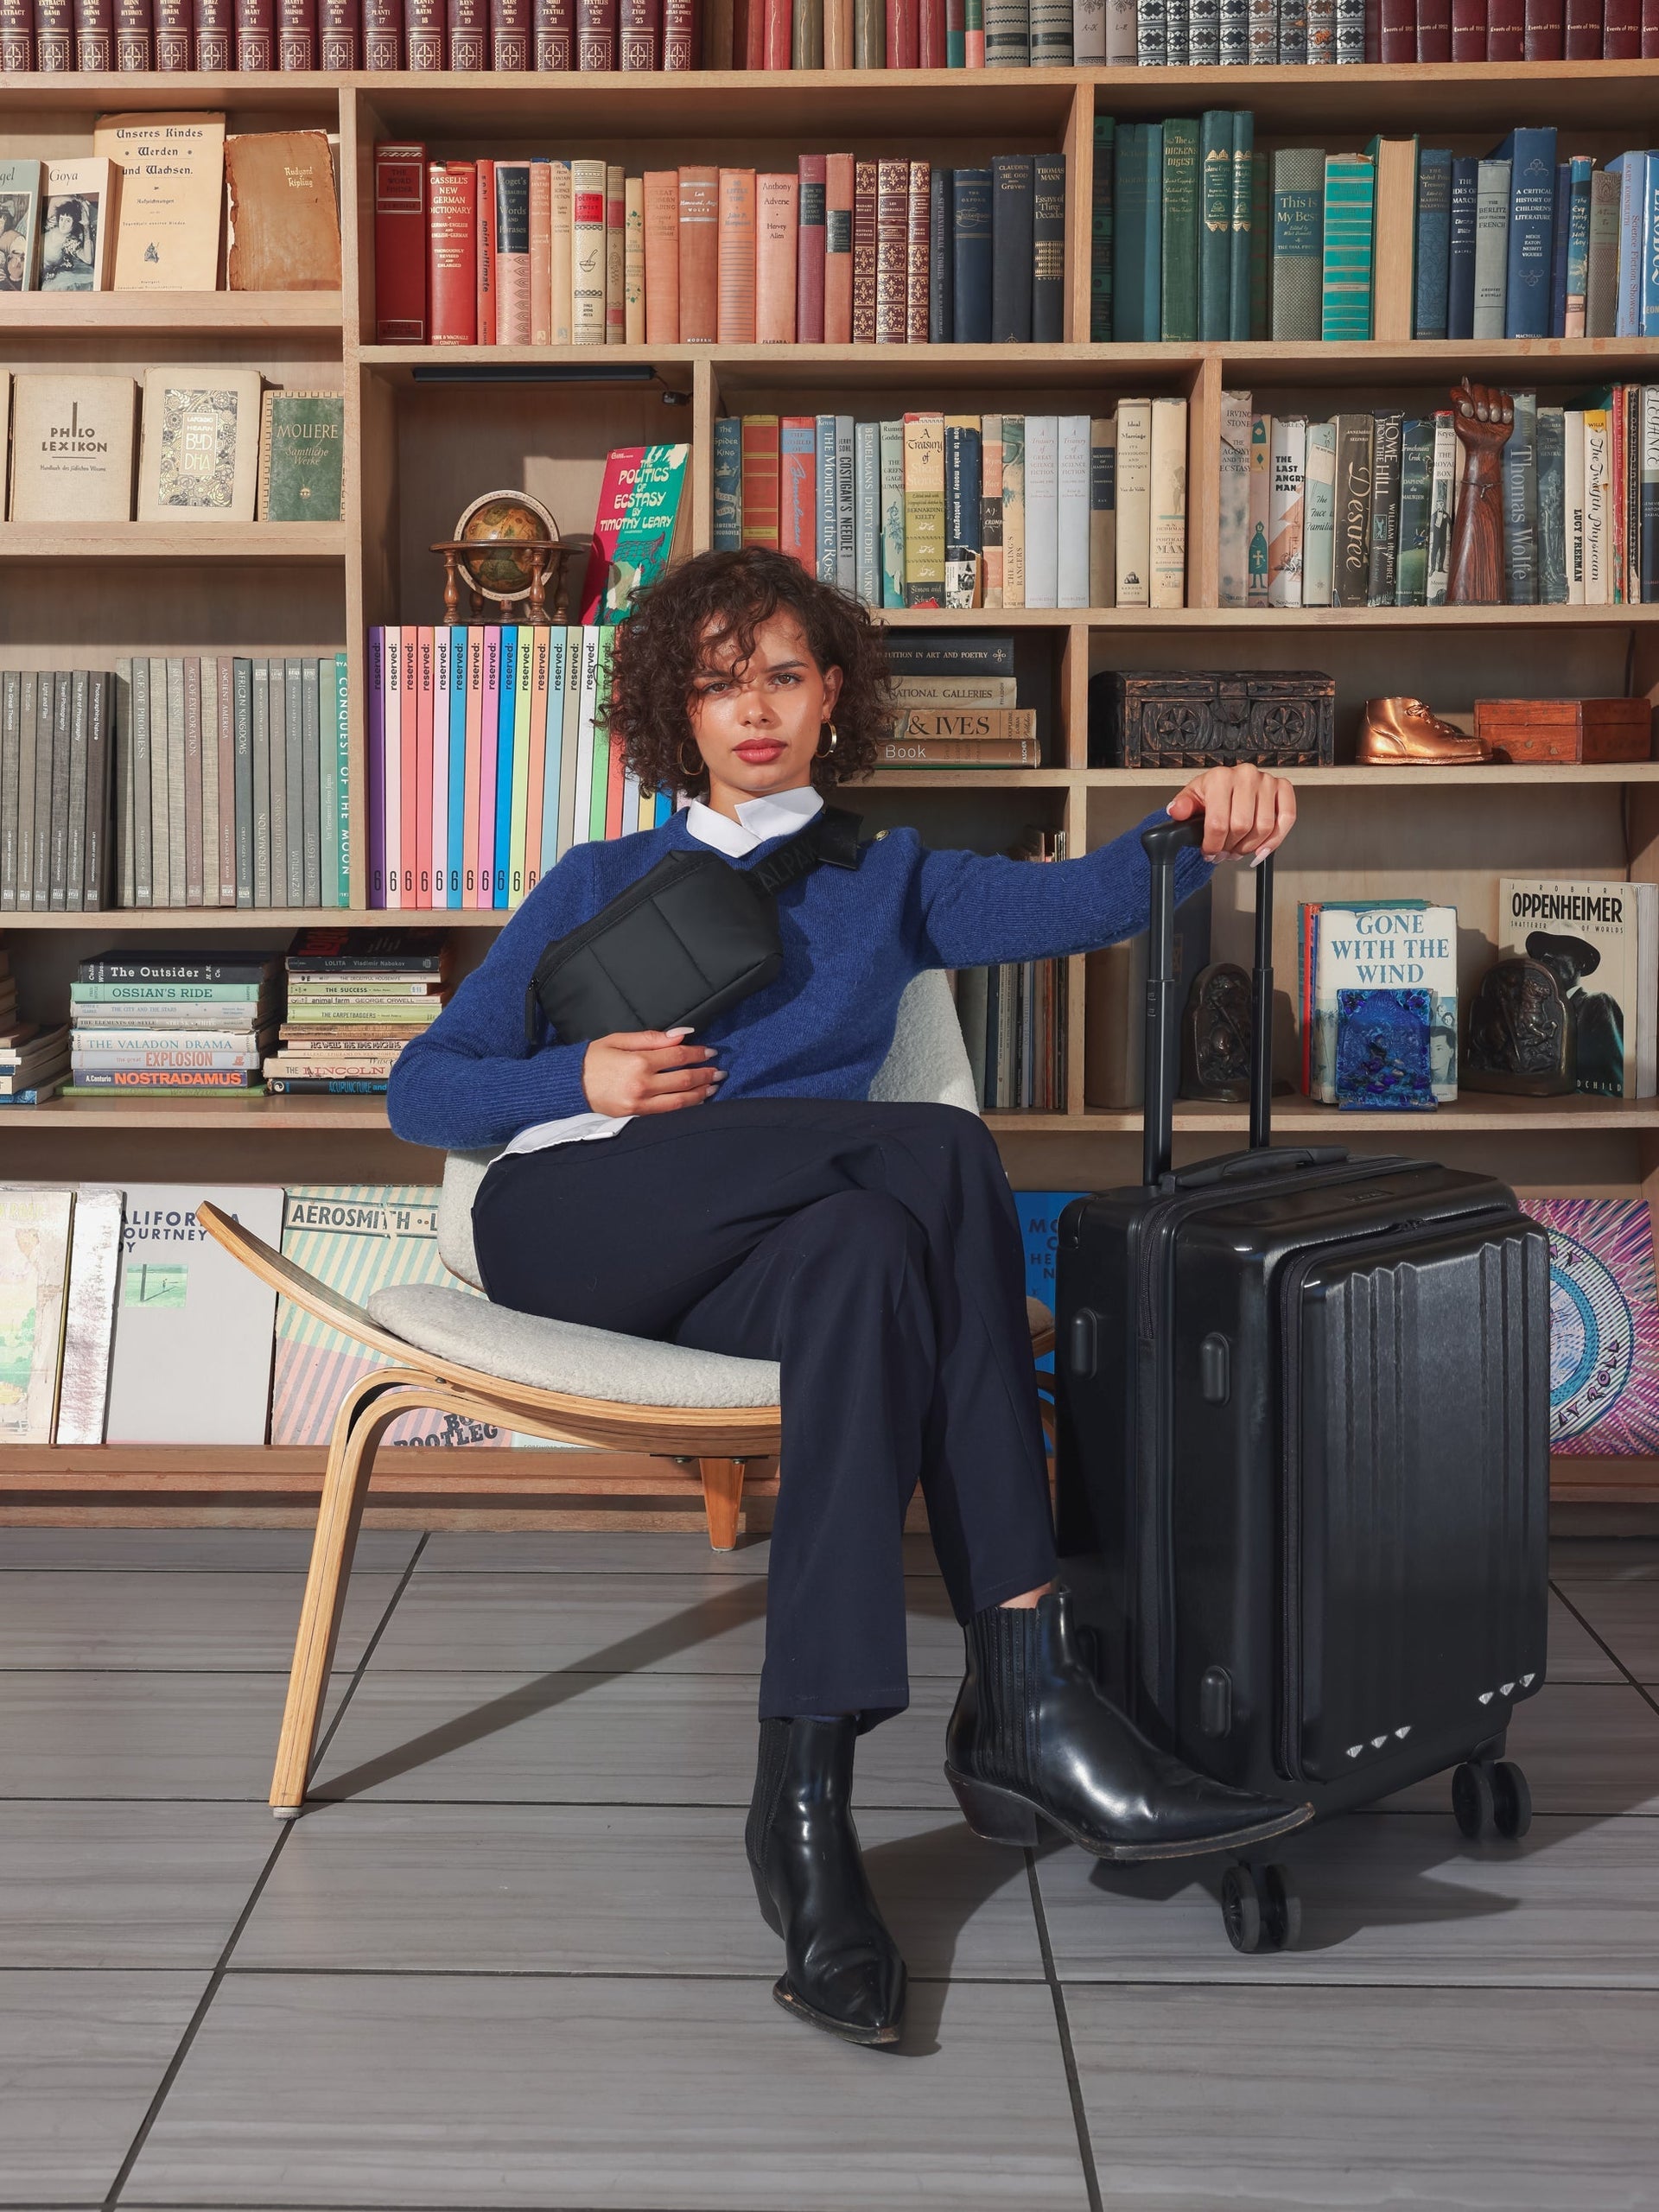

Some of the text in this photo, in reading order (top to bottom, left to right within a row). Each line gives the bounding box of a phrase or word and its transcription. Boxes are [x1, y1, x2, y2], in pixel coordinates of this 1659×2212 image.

[117, 128, 203, 139] Unseres Kindes
[138, 147, 178, 156] Werden
[49, 168, 79, 186] Goya
[762, 181, 791, 192] Anthony
[764, 197, 790, 207] Adverse
[1280, 196, 1318, 208] This Is
[766, 222, 787, 232] Hervey
[1277, 213, 1294, 224] My
[50, 401, 95, 438] PHILO
[1227, 410, 1251, 418] IRVING
[920, 429, 931, 439] A
[1383, 416, 1400, 463] HOME
[41, 442, 107, 453] LEXIKON
[907, 440, 943, 454] Treasury
[1375, 448, 1384, 464] THE
[1590, 438, 1604, 462] The
[640, 459, 653, 468] THE
[618, 467, 670, 486] POLITICS
[1374, 465, 1389, 500] HILL
[637, 483, 647, 493] OF
[864, 427, 874, 563] BEMELMANS DIRTY EDDIE
[613, 491, 667, 510] ECSTASY
[823, 431, 835, 582] THE Moment of the Rose
[839, 457, 854, 551] COSTIGAN'S NEEDLE
[632, 507, 642, 517] BY
[953, 502, 962, 540] photography
[1510, 445, 1533, 581] Thomas Wolfe
[600, 515, 674, 532] TIMOTHY LEARY
[1384, 503, 1396, 586] WILLIAM HUMPHREY
[1573, 509, 1583, 582] LUCY FREEMAN
[554, 642, 563, 691] reserved:
[570, 642, 579, 691] reserved:
[943, 690, 993, 699] GALLERIES
[238, 706, 247, 754] KINGDOMS
[907, 715, 931, 735] &
[936, 716, 990, 734] IVES
[885, 744, 927, 759] Book
[339, 677, 349, 875] CONQUEST OF THE MOON
[390, 870, 397, 892] 6
[436, 870, 443, 892] 6
[451, 870, 459, 892] 6
[467, 870, 474, 892] 6
[481, 870, 490, 892] 6
[497, 870, 505, 892] 6
[513, 870, 521, 892] 6
[1512, 892, 1624, 923] OPPENHEIMER
[1356, 914, 1424, 935] GONE
[1510, 920, 1548, 930] SHATTERER
[1594, 925, 1624, 934] WORLDS
[1332, 938, 1450, 960] WITH THE
[111, 967, 200, 977] The Outsider
[1358, 963, 1424, 984] WIND
[111, 988, 213, 998] OSSIAN'S RIDE
[87, 1039, 232, 1049] THE VALADON DRAMA
[145, 1052, 213, 1067] EXPLOSION
[114, 1071, 243, 1085] NOSTRADAMUS
[292, 1205, 410, 1230] AEROSMITH
[123, 1227, 208, 1241] OURTNEY
